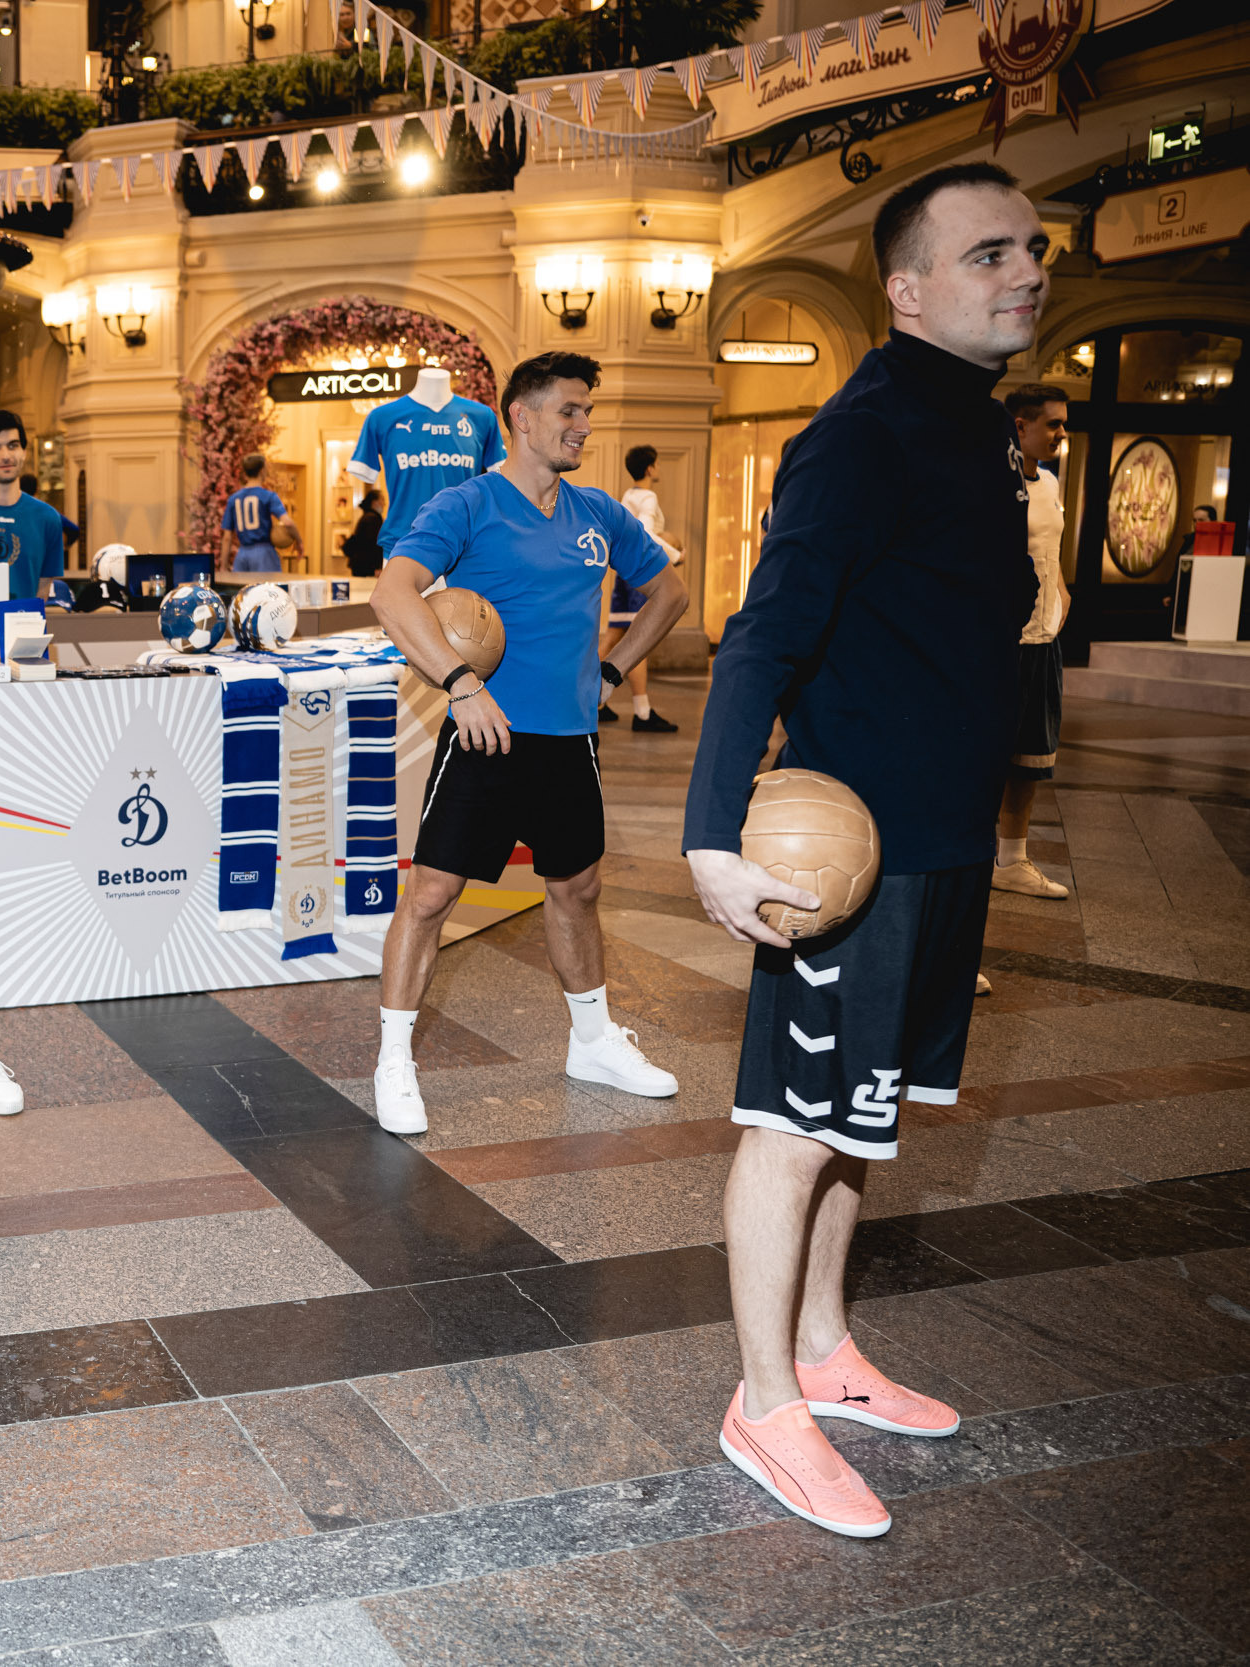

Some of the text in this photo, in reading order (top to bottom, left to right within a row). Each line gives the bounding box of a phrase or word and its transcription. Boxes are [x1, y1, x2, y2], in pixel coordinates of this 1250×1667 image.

[820, 47, 911, 83] магзин
[1024, 32, 1068, 80] ПЛОЩАДЬ
[1011, 83, 1043, 109] GUM
[1165, 198, 1178, 218] 2
[1133, 222, 1208, 247] ЛИНИЯ LINE
[302, 372, 402, 397] ARTICOLI
[431, 424, 451, 436] ВТБ
[396, 449, 475, 471] BetBoom
[235, 495, 260, 532] 10
[289, 746, 330, 868] ДИНАМО
[97, 868, 188, 886] BetBoom
[105, 888, 181, 900] Титульный спонсор
